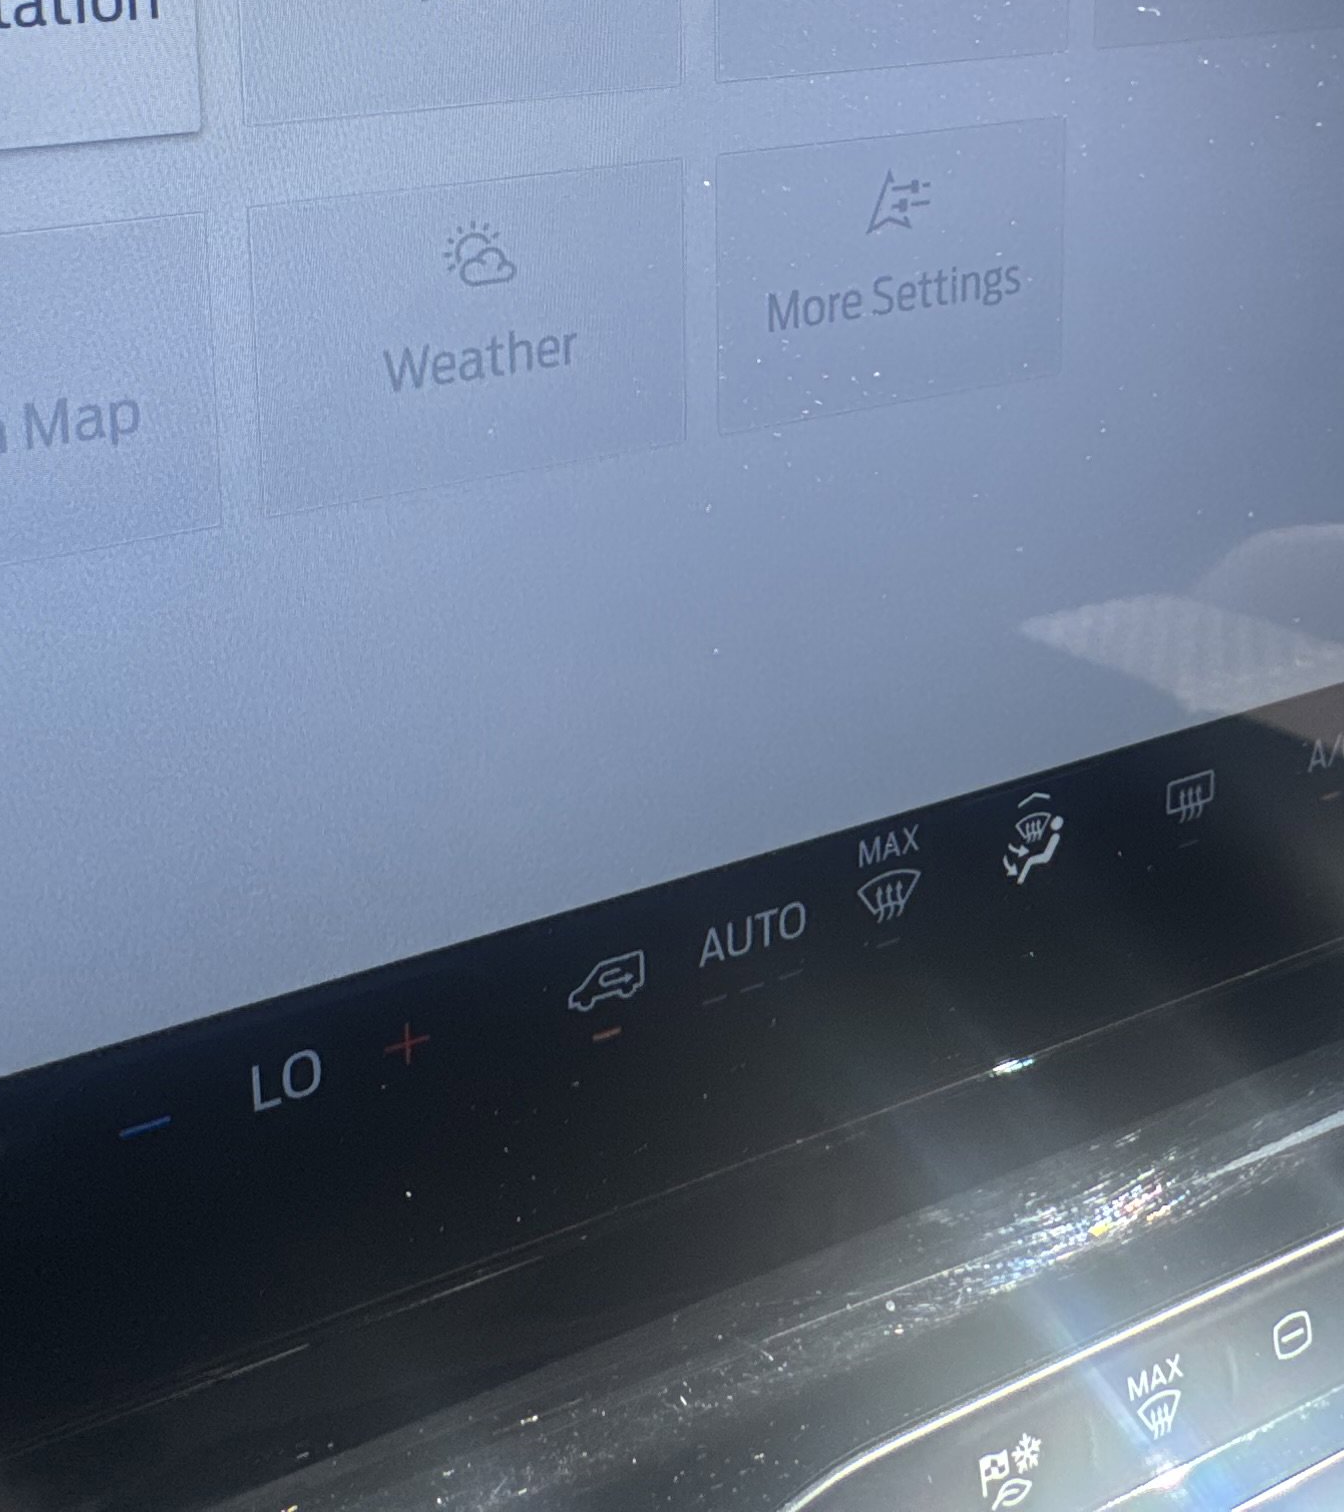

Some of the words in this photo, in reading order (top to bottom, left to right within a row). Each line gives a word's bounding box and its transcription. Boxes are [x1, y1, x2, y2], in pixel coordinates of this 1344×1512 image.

[767, 288, 863, 333] More
[871, 264, 1021, 316] Settings
[383, 326, 579, 393] Weather
[22, 395, 142, 451] Map
[858, 823, 921, 868] MAX
[699, 901, 807, 968] AUTO
[250, 1048, 323, 1112] LO
[1127, 1354, 1186, 1403] MAX
